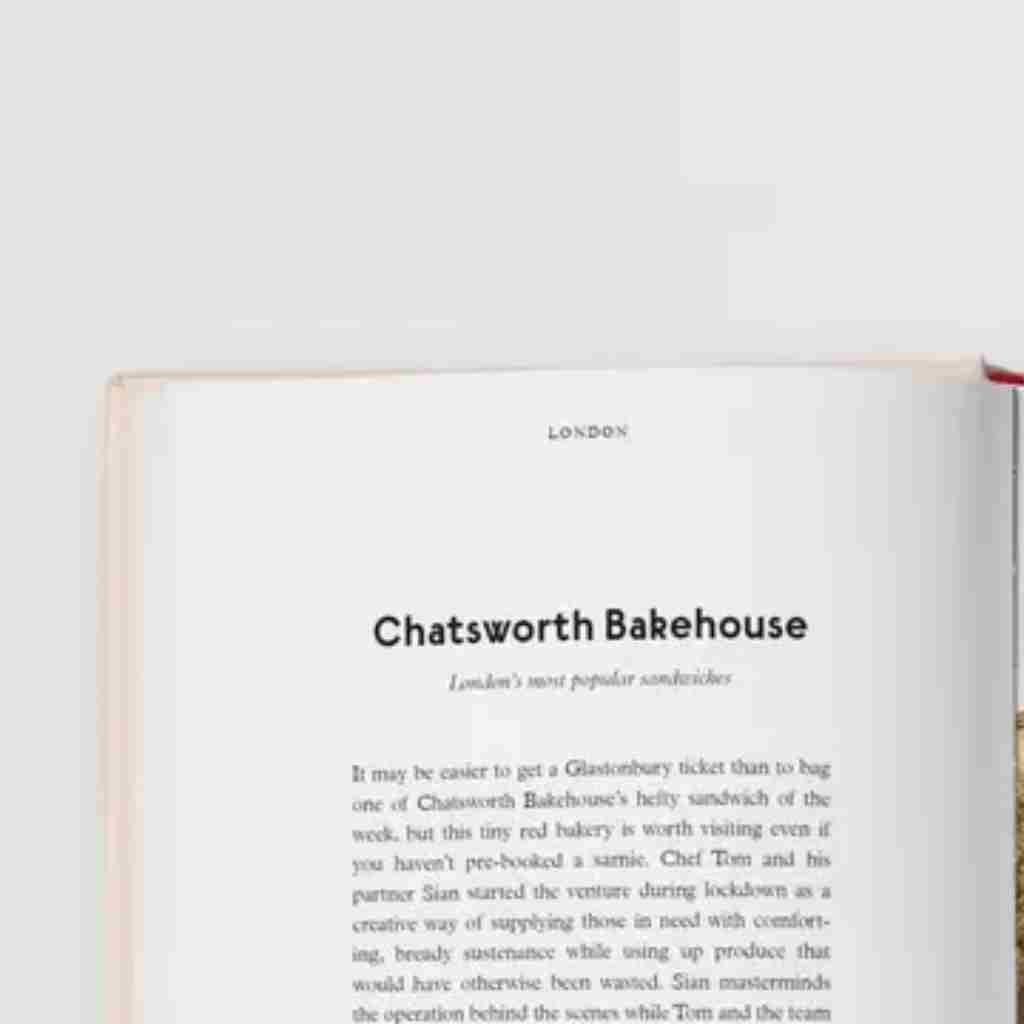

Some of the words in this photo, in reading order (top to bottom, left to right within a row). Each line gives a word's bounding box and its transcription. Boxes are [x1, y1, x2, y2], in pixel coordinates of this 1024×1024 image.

[548, 424, 628, 440] LONDON
[373, 609, 594, 647] Chatsworth
[605, 608, 808, 641] Bakehouse
[527, 675, 566, 688] most
[570, 669, 636, 692] popular
[640, 668, 732, 686] sandwiches
[371, 769, 408, 785] may
[439, 763, 489, 780] easier
[517, 764, 544, 782] get
[564, 760, 673, 779] Glastonbury
[678, 759, 726, 775] ticket
[730, 758, 771, 776] than
[798, 758, 832, 780] bag
[352, 799, 384, 813] one
[417, 793, 516, 811] Chatsworth
[636, 790, 680, 809] hefty
[688, 789, 770, 807] sandwich
[804, 790, 832, 808] the
[406, 825, 435, 842] but
[442, 824, 472, 840] this
[480, 823, 512, 842] tiny
[520, 822, 548, 840] red
[555, 821, 615, 841] bakery
[642, 820, 694, 837] worth
[700, 820, 763, 841] visiting
[769, 824, 811, 837] even
[352, 859, 384, 877] you
[466, 853, 564, 874] pre-booked
[659, 850, 704, 867] Chef
[710, 849, 752, 867] Tom
[762, 851, 795, 868] and
[806, 850, 832, 868] his
[352, 889, 416, 907] partner
[422, 884, 461, 902] Sian
[466, 883, 526, 900] started
[533, 883, 560, 900] the
[566, 885, 632, 899] venture
[638, 882, 696, 902] during
[705, 881, 788, 899] lockdown
[352, 918, 418, 933] creative
[424, 919, 458, 935] way
[491, 913, 575, 934] supplying
[581, 913, 627, 929] those
[659, 912, 701, 929] need
[708, 912, 746, 929] with
[394, 945, 453, 965] bready
[463, 947, 555, 961] sustenance
[566, 943, 612, 960] while
[622, 946, 670, 963] using
[714, 942, 786, 963] produce
[796, 942, 831, 960] that
[352, 976, 405, 992] would
[412, 976, 452, 993] have
[460, 976, 542, 991] otherwise
[550, 974, 592, 991] been
[671, 972, 711, 991] Sian
[719, 974, 832, 991] masterminds
[352, 1006, 379, 1023] the
[384, 1006, 464, 1024] operation
[469, 1004, 529, 1022] behind
[533, 1004, 560, 1021] the
[565, 1008, 620, 1021] scenes
[624, 1004, 670, 1021] while
[672, 1002, 714, 1021] Tom
[718, 1004, 752, 1021] and
[756, 1004, 784, 1021] the
[788, 1006, 831, 1022] team
